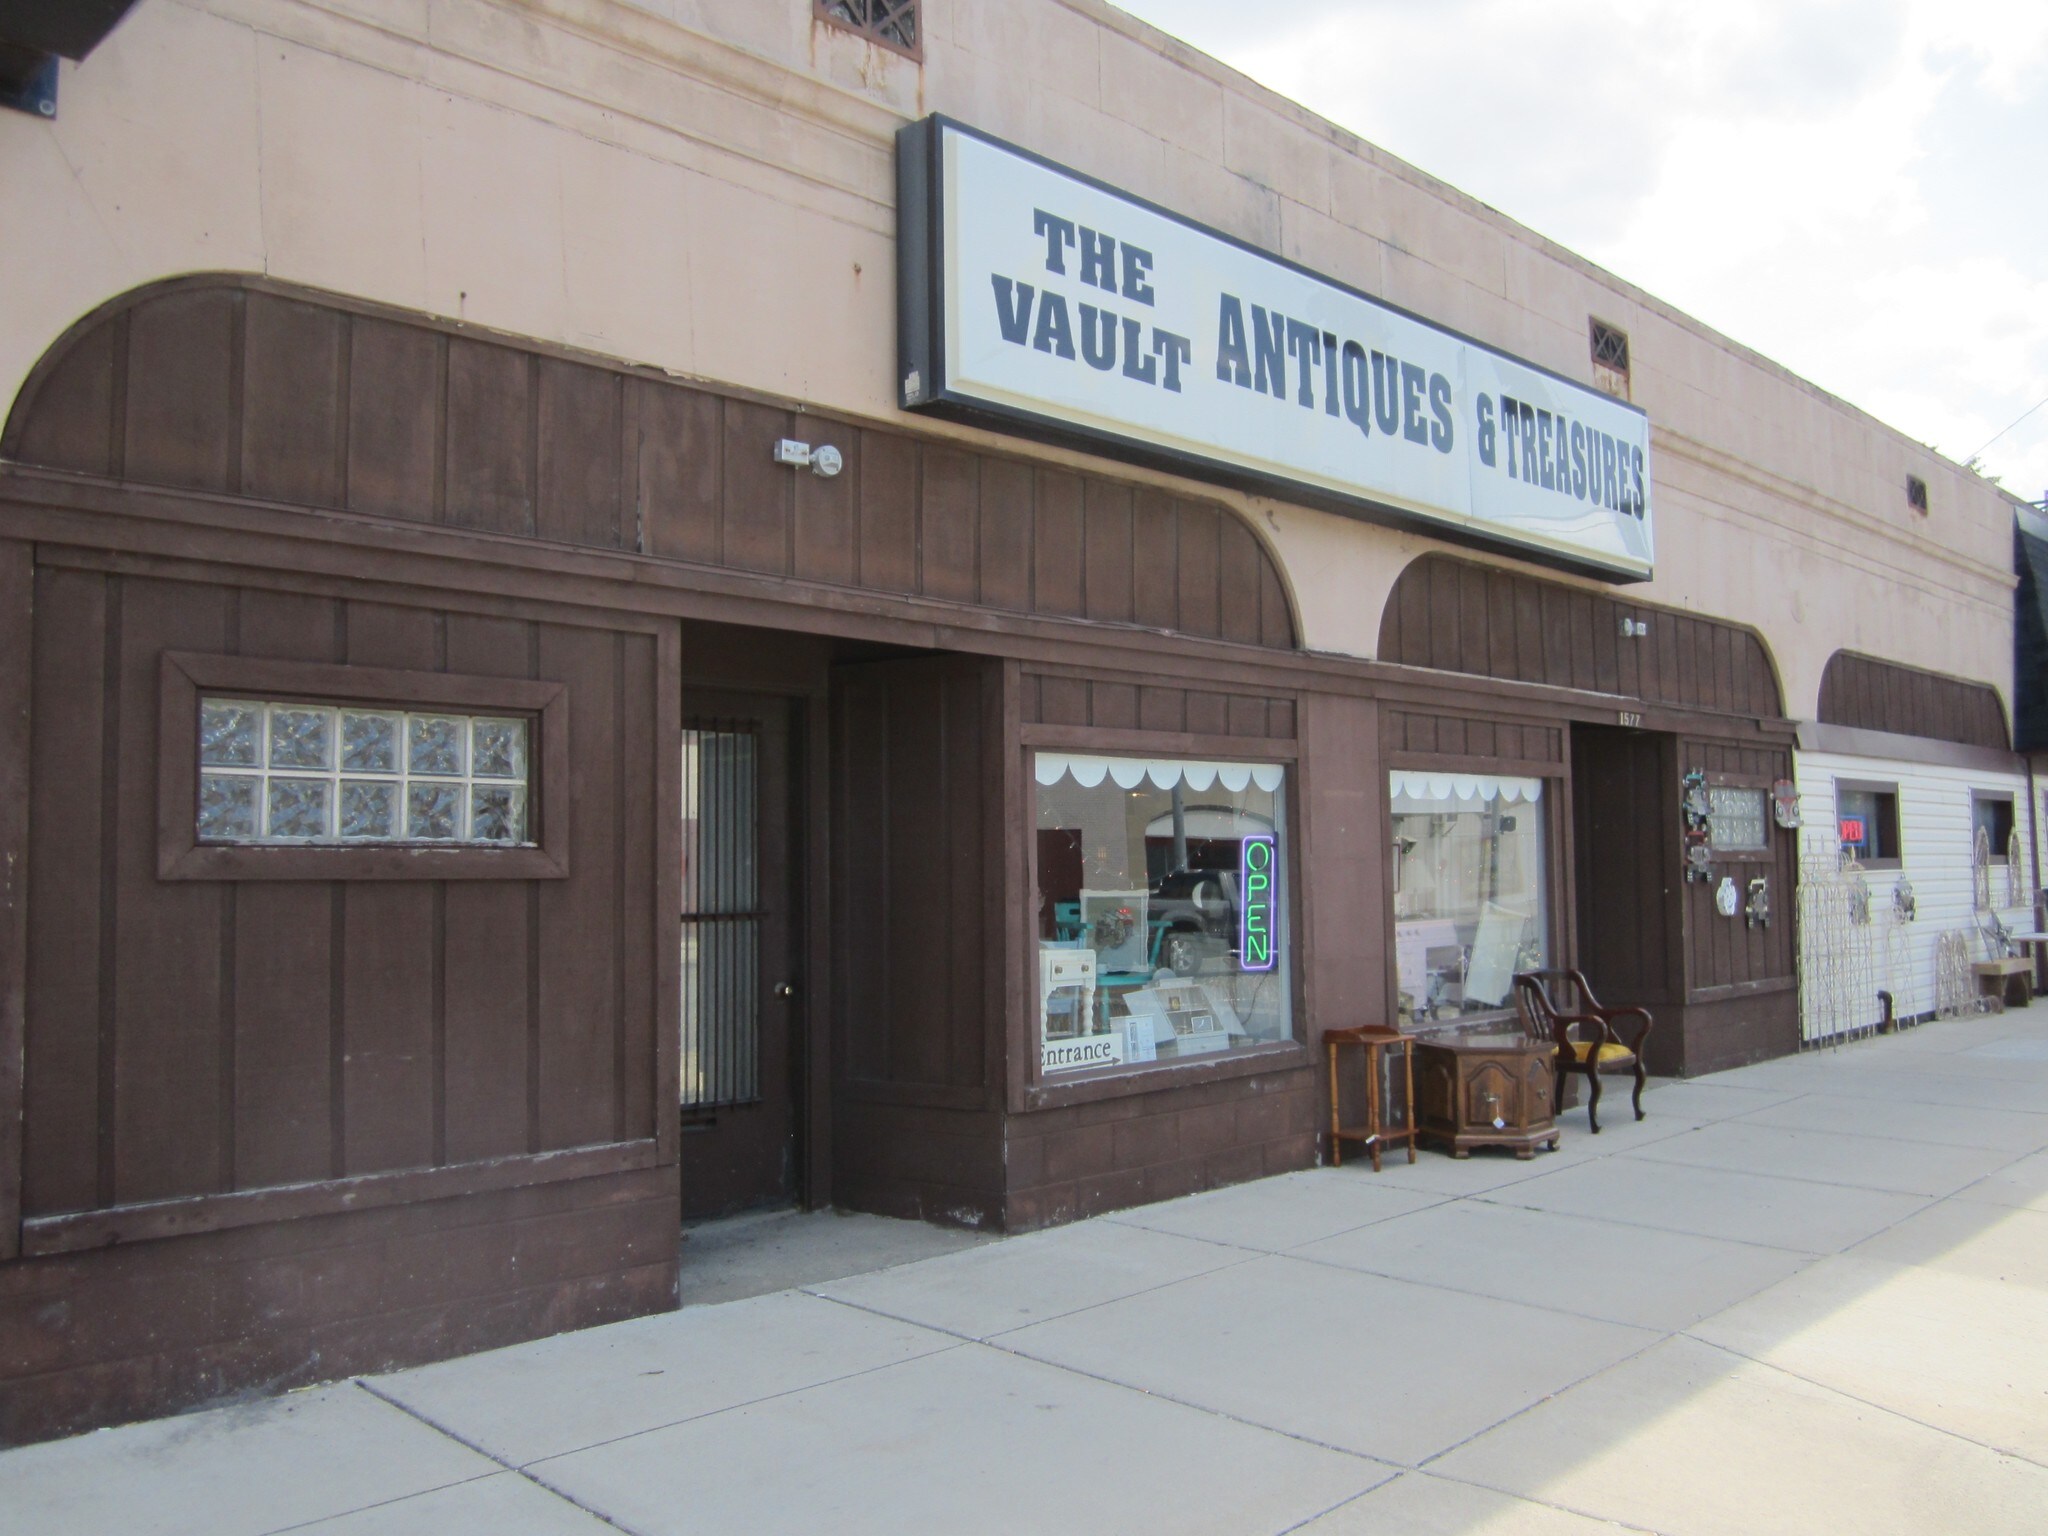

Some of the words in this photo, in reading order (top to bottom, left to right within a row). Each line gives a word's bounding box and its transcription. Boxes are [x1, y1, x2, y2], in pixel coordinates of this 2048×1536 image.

[1033, 207, 1155, 308] THE
[991, 272, 1191, 393] VAULT
[1216, 292, 1454, 454] ANTIQUES
[1476, 392, 1496, 468] &
[1500, 394, 1645, 521] TREASURES
[1620, 711, 1641, 728] 1577
[1246, 842, 1269, 962] OPEN
